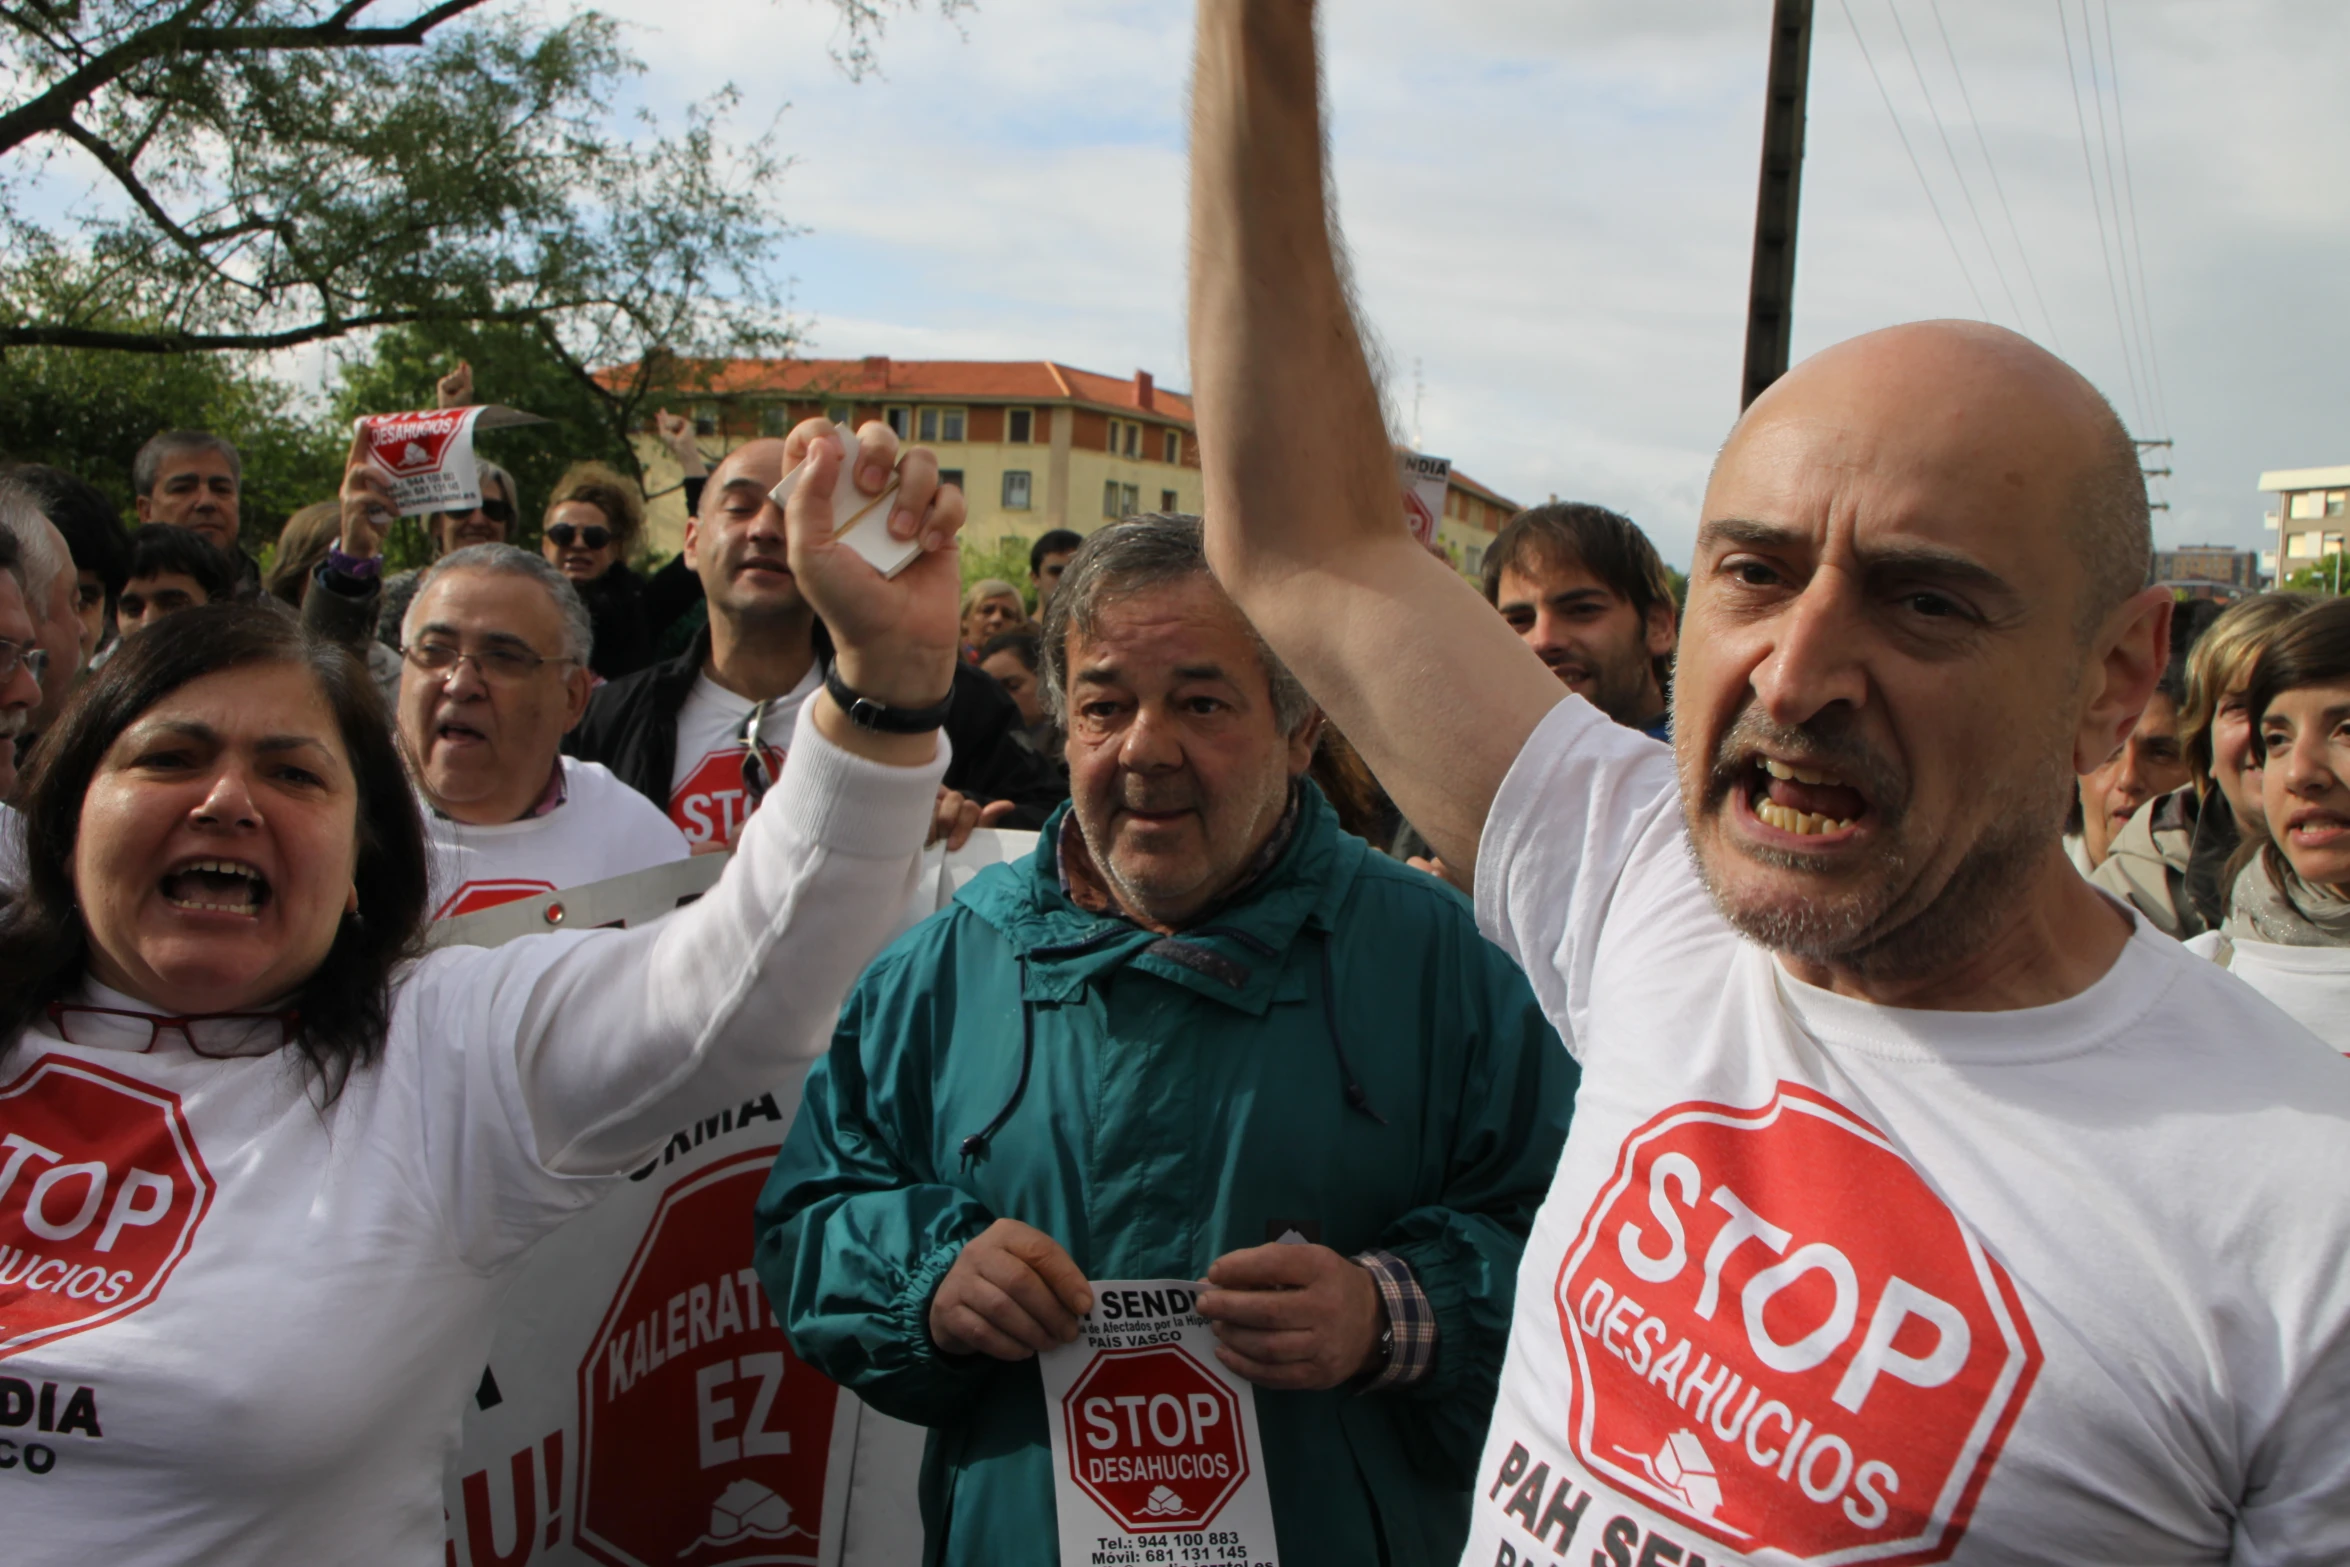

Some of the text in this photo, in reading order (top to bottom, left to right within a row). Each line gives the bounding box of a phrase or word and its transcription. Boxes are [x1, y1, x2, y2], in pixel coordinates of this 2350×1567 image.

[372, 417, 453, 447] DESAHUCIOS
[683, 789, 752, 843] ST
[0, 1132, 174, 1253] TOP
[0, 1244, 134, 1303] UCIOS
[1618, 1151, 1972, 1415] STOP
[1088, 1330, 1182, 1348] PAÍS VASCO
[1089, 1324, 1100, 1334] de
[1103, 1320, 1152, 1334] Afectados
[1154, 1320, 1171, 1333] por
[1173, 1316, 1184, 1328] la
[0, 1376, 104, 1438] DIA
[696, 1351, 791, 1470] EZ
[1083, 1393, 1220, 1450] STOP
[1579, 1277, 1899, 1530] DESAHUCIOS
[1089, 1453, 1230, 1483] DESAHUCIOS
[1489, 1440, 1593, 1557] PAH
[1091, 1551, 1141, 1565] Móvil:
[1145, 1549, 1174, 1563] 681
[1181, 1547, 1210, 1561] 131
[1217, 1545, 1247, 1560] 145
[1097, 1531, 1239, 1550] Tel.: 944 100 883
